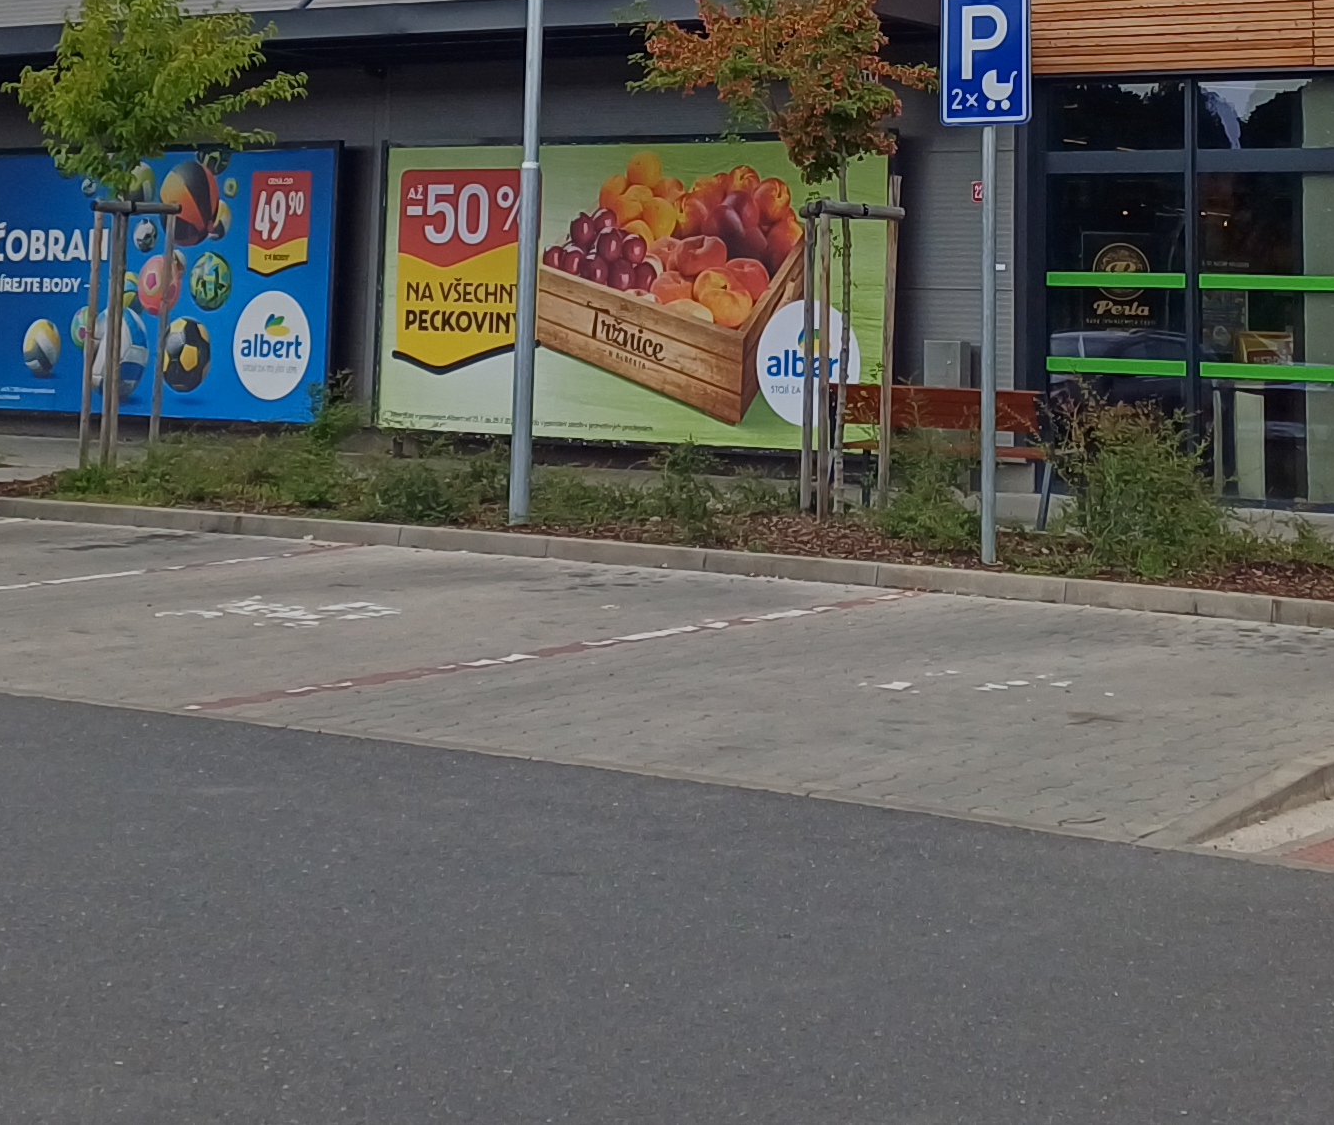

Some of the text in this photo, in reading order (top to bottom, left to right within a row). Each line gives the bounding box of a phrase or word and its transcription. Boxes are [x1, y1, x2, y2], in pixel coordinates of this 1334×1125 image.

[961, 4, 1008, 80] P
[407, 184, 424, 200] AŽ
[42, 277, 82, 293] BODY
[406, 281, 434, 303] NA
[1093, 300, 1150, 316] Perla
[586, 301, 667, 362] Tržnice
[240, 333, 303, 360] albert
[766, 349, 839, 378] albr
